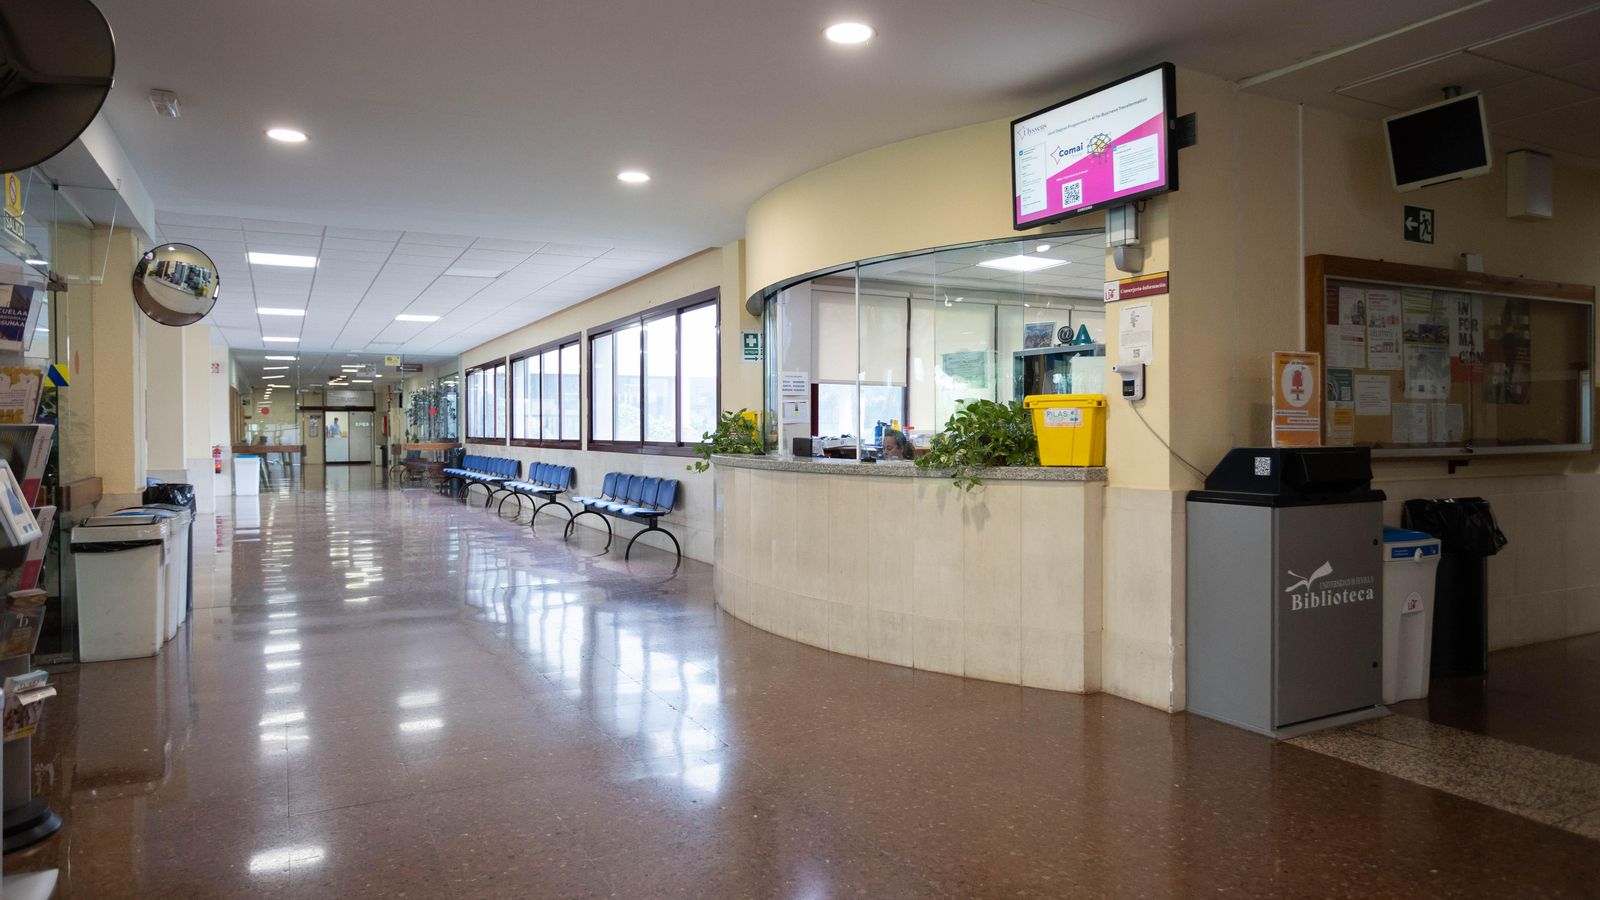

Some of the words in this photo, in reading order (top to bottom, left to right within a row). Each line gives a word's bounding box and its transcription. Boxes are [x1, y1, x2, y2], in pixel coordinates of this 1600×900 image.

[1059, 142, 1084, 158] Comai
[5, 213, 24, 237] SALIDA
[1457, 301, 1469, 315] IN
[1458, 317, 1478, 332] FOR
[1073, 323, 1092, 345] A
[1458, 332, 1474, 346] MA
[1046, 410, 1068, 418] PILAS
[1290, 588, 1374, 611] Biblioteca
